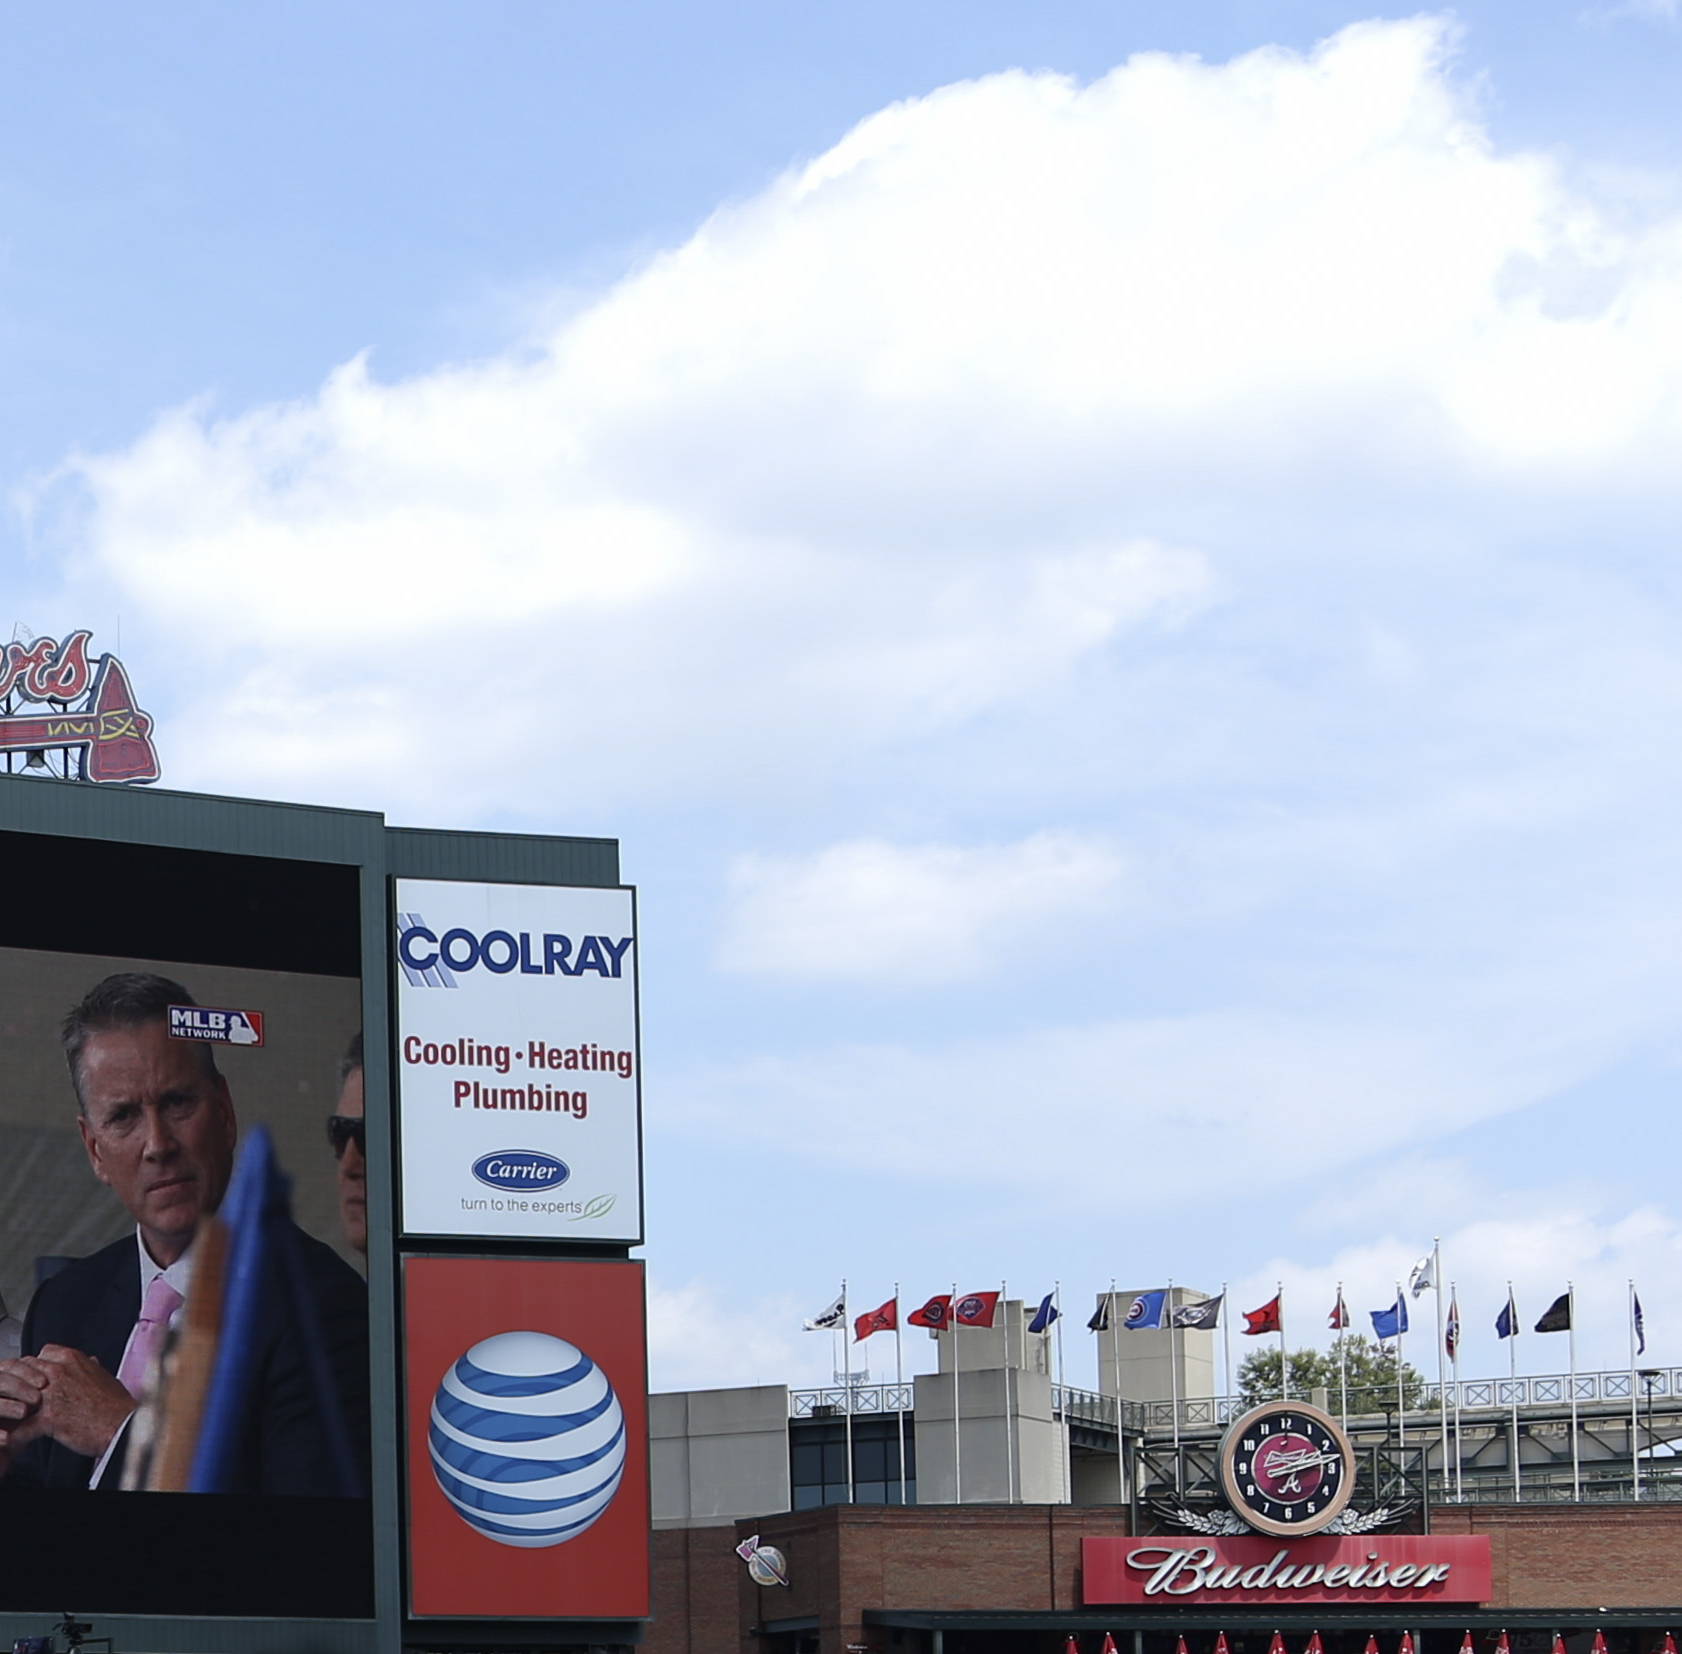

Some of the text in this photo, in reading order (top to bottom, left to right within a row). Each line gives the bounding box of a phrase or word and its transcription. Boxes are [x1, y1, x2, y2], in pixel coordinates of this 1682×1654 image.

[399, 926, 634, 978] COOLRAY
[171, 1009, 226, 1030] MLB
[171, 1027, 226, 1040] NETWORK
[404, 1035, 632, 1079] Cooling Heating
[454, 1080, 587, 1119] Plumbing
[487, 1160, 557, 1180] Carrier
[461, 1198, 582, 1215] turn to the experts
[1126, 1546, 1450, 1596] Budweiser
